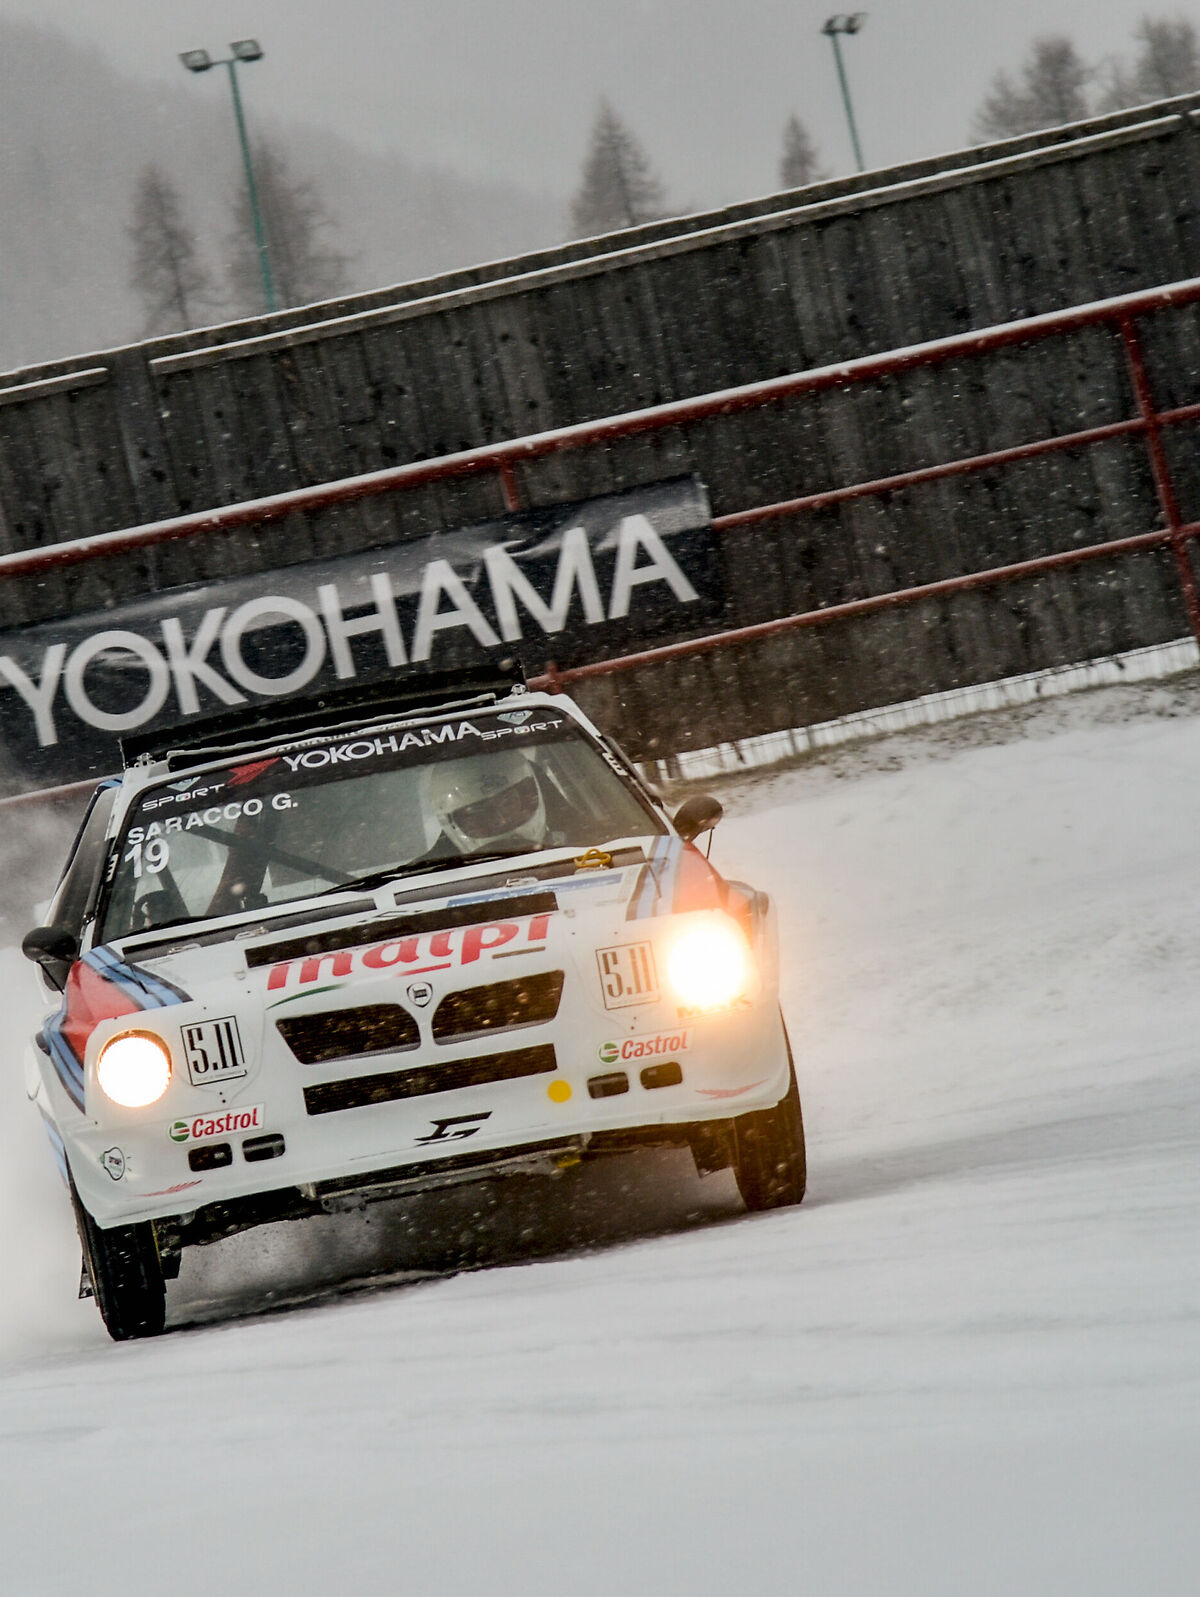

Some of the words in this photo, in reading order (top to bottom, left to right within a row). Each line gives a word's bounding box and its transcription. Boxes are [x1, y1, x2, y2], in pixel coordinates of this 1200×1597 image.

[282, 721, 482, 772] YOKOHAMA
[481, 719, 563, 740] SPORT
[142, 783, 226, 811] SPORT
[127, 798, 263, 845] SARACCO
[271, 792, 299, 810] G.
[124, 838, 170, 879] 19
[267, 913, 553, 990] inalpi
[621, 1031, 688, 1060] Castrol
[191, 1107, 259, 1138] Castrol
